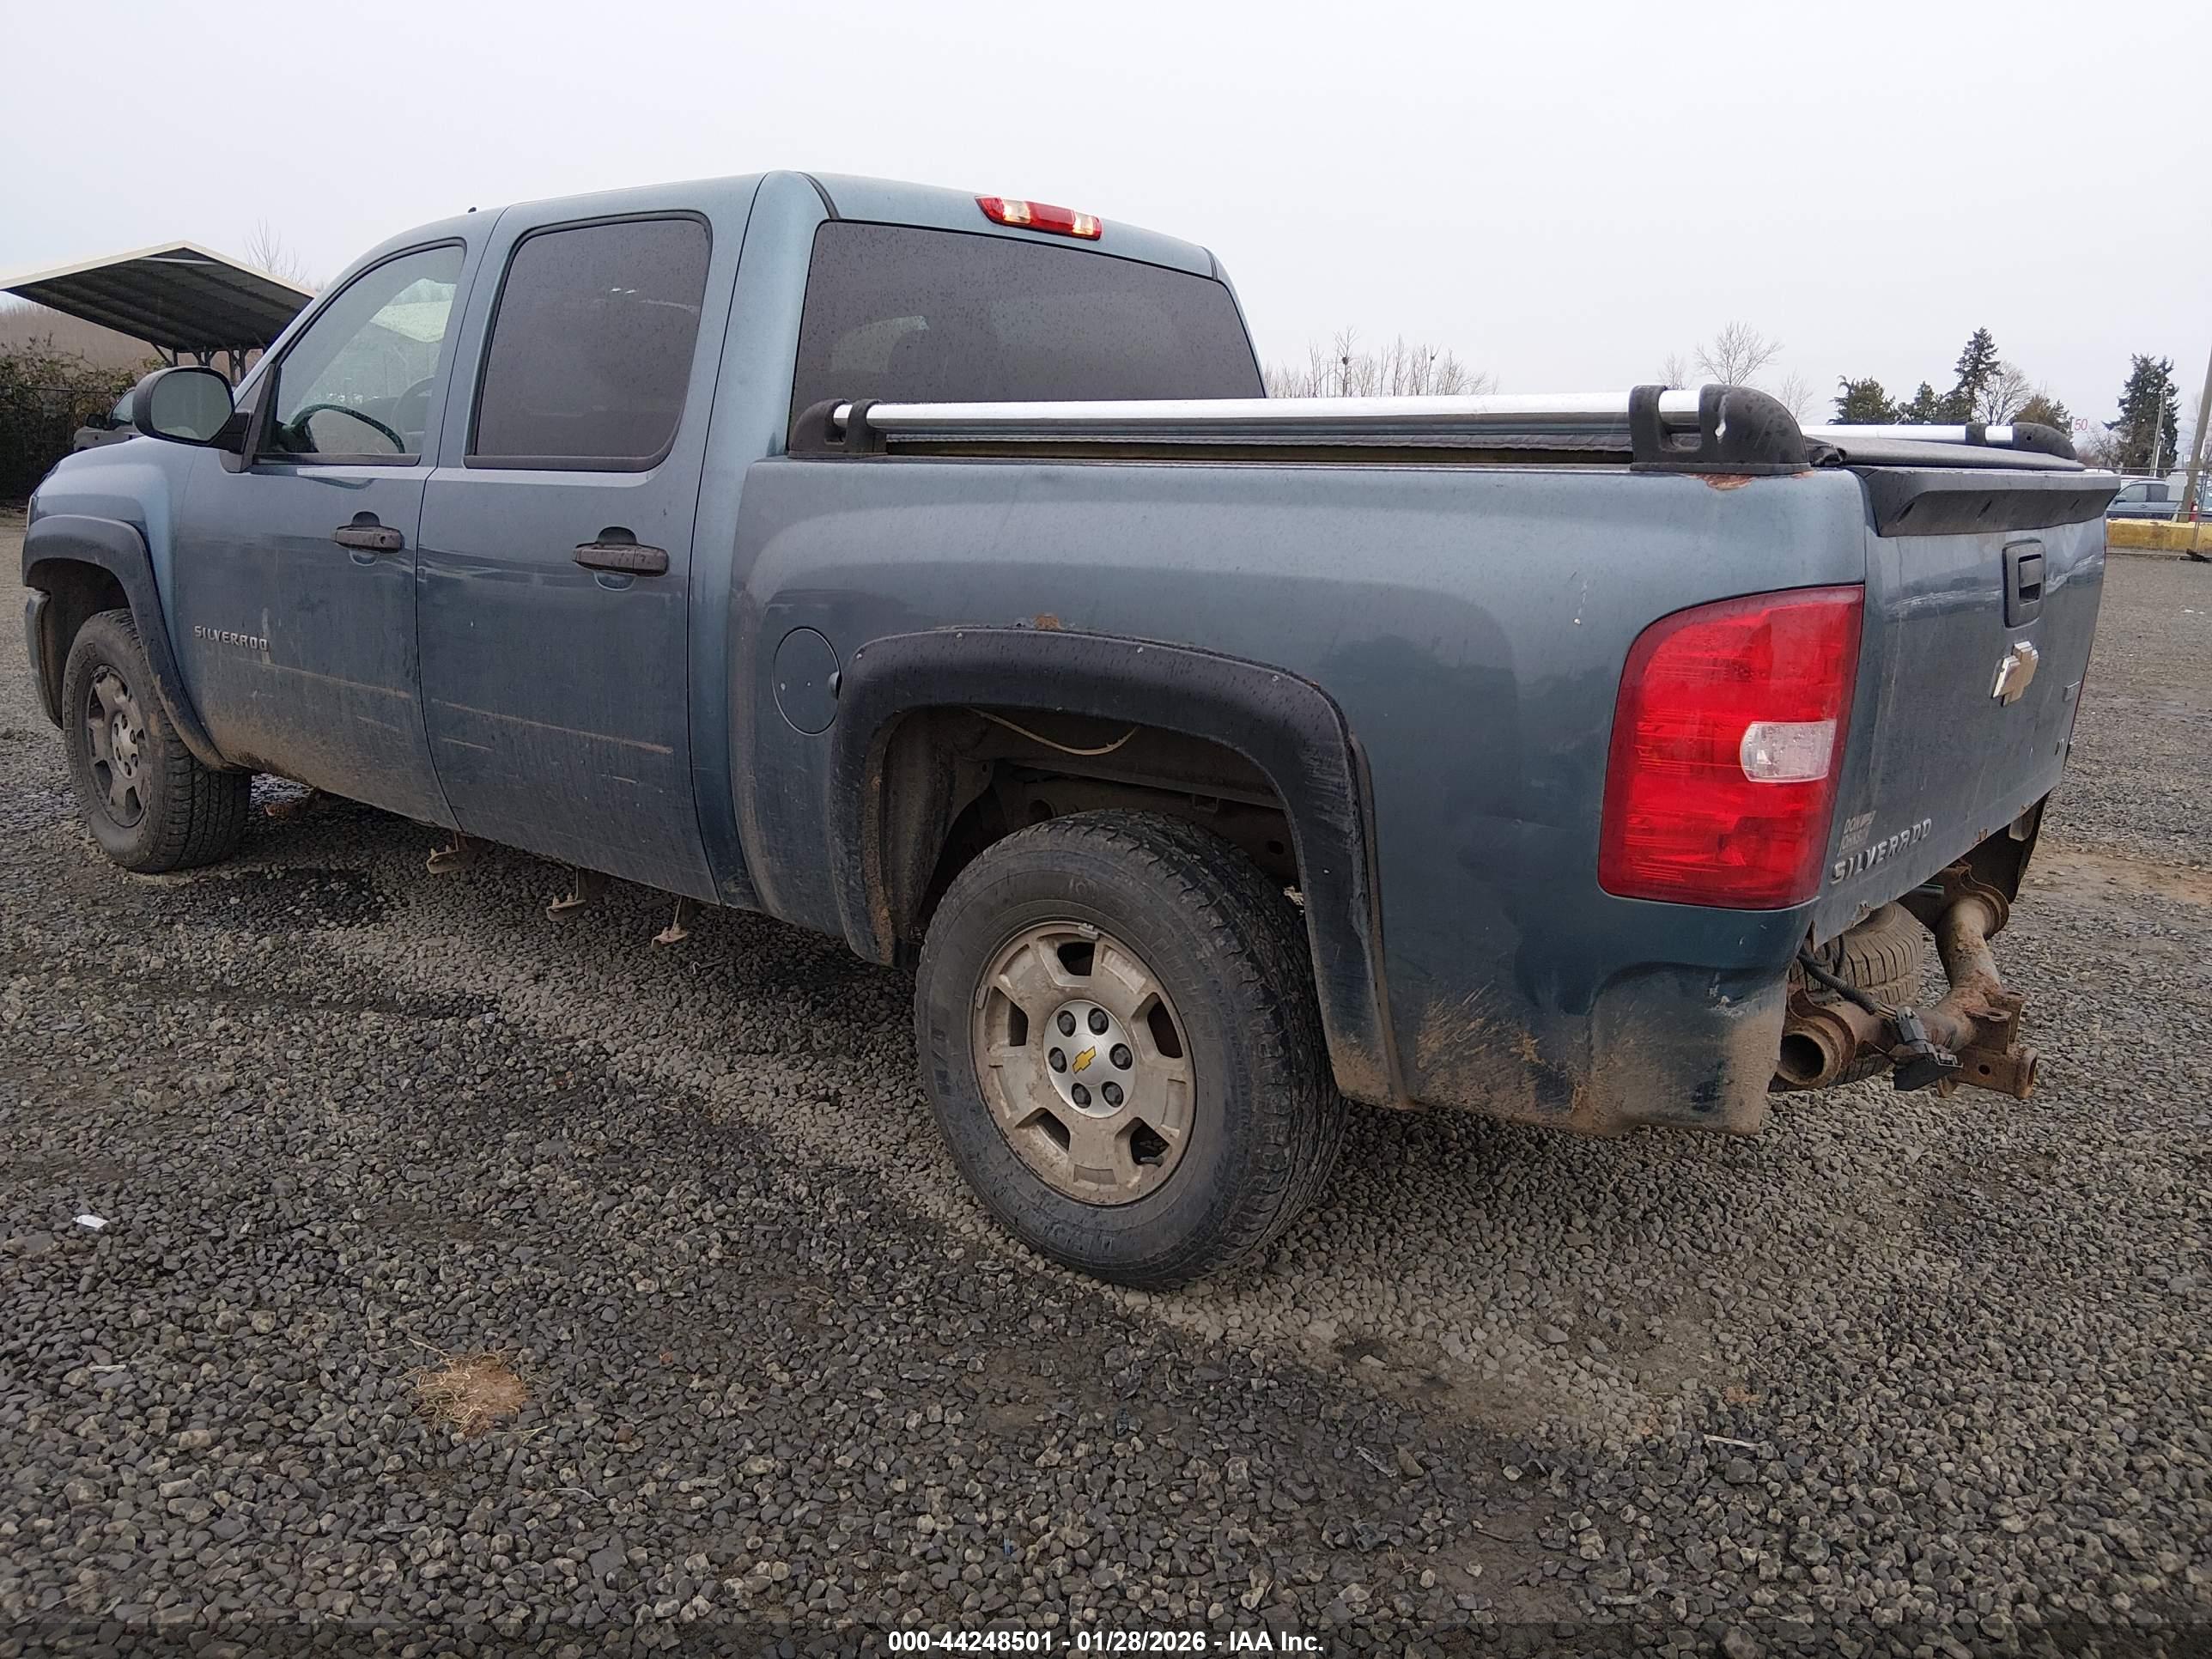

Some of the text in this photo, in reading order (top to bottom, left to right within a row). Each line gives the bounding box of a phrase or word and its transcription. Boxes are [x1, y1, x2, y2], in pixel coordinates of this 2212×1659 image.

[2074, 418, 2088, 431] 50
[194, 625, 268, 651] SILVERADO
[1830, 817, 1932, 884] SILVERADO
